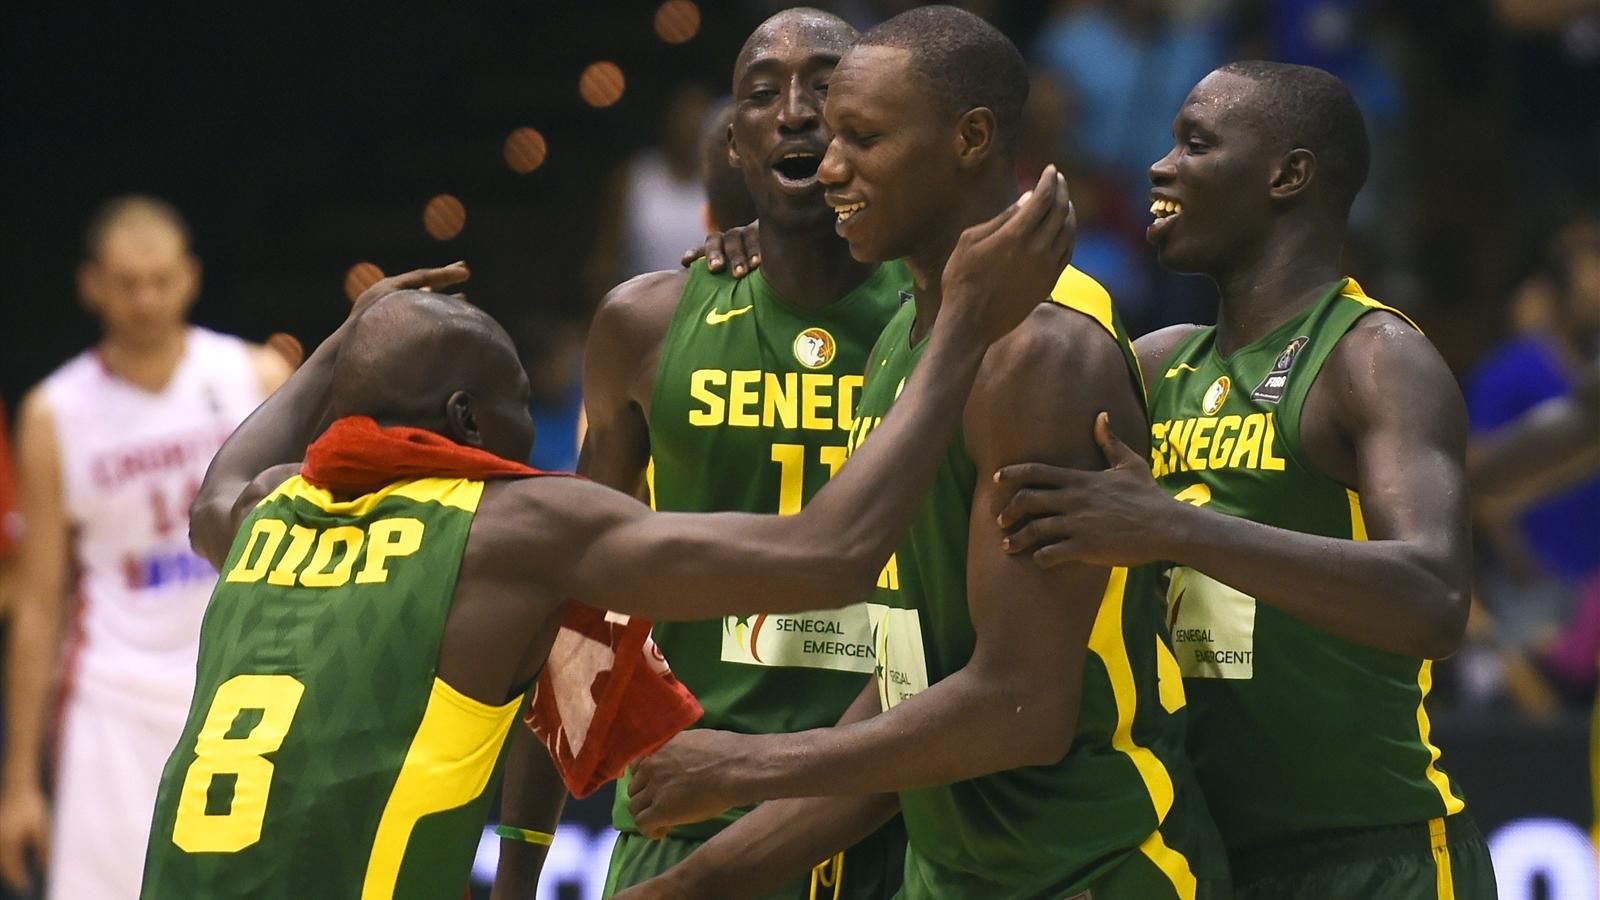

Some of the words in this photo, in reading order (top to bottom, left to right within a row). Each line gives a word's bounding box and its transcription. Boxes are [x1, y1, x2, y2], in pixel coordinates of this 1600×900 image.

[688, 369, 865, 431] SENEG
[1264, 375, 1287, 388] FIBA
[225, 517, 425, 588] DIOP
[776, 618, 845, 635] SENEGAL
[803, 640, 876, 658] EMERGEN
[172, 674, 305, 853] 8
